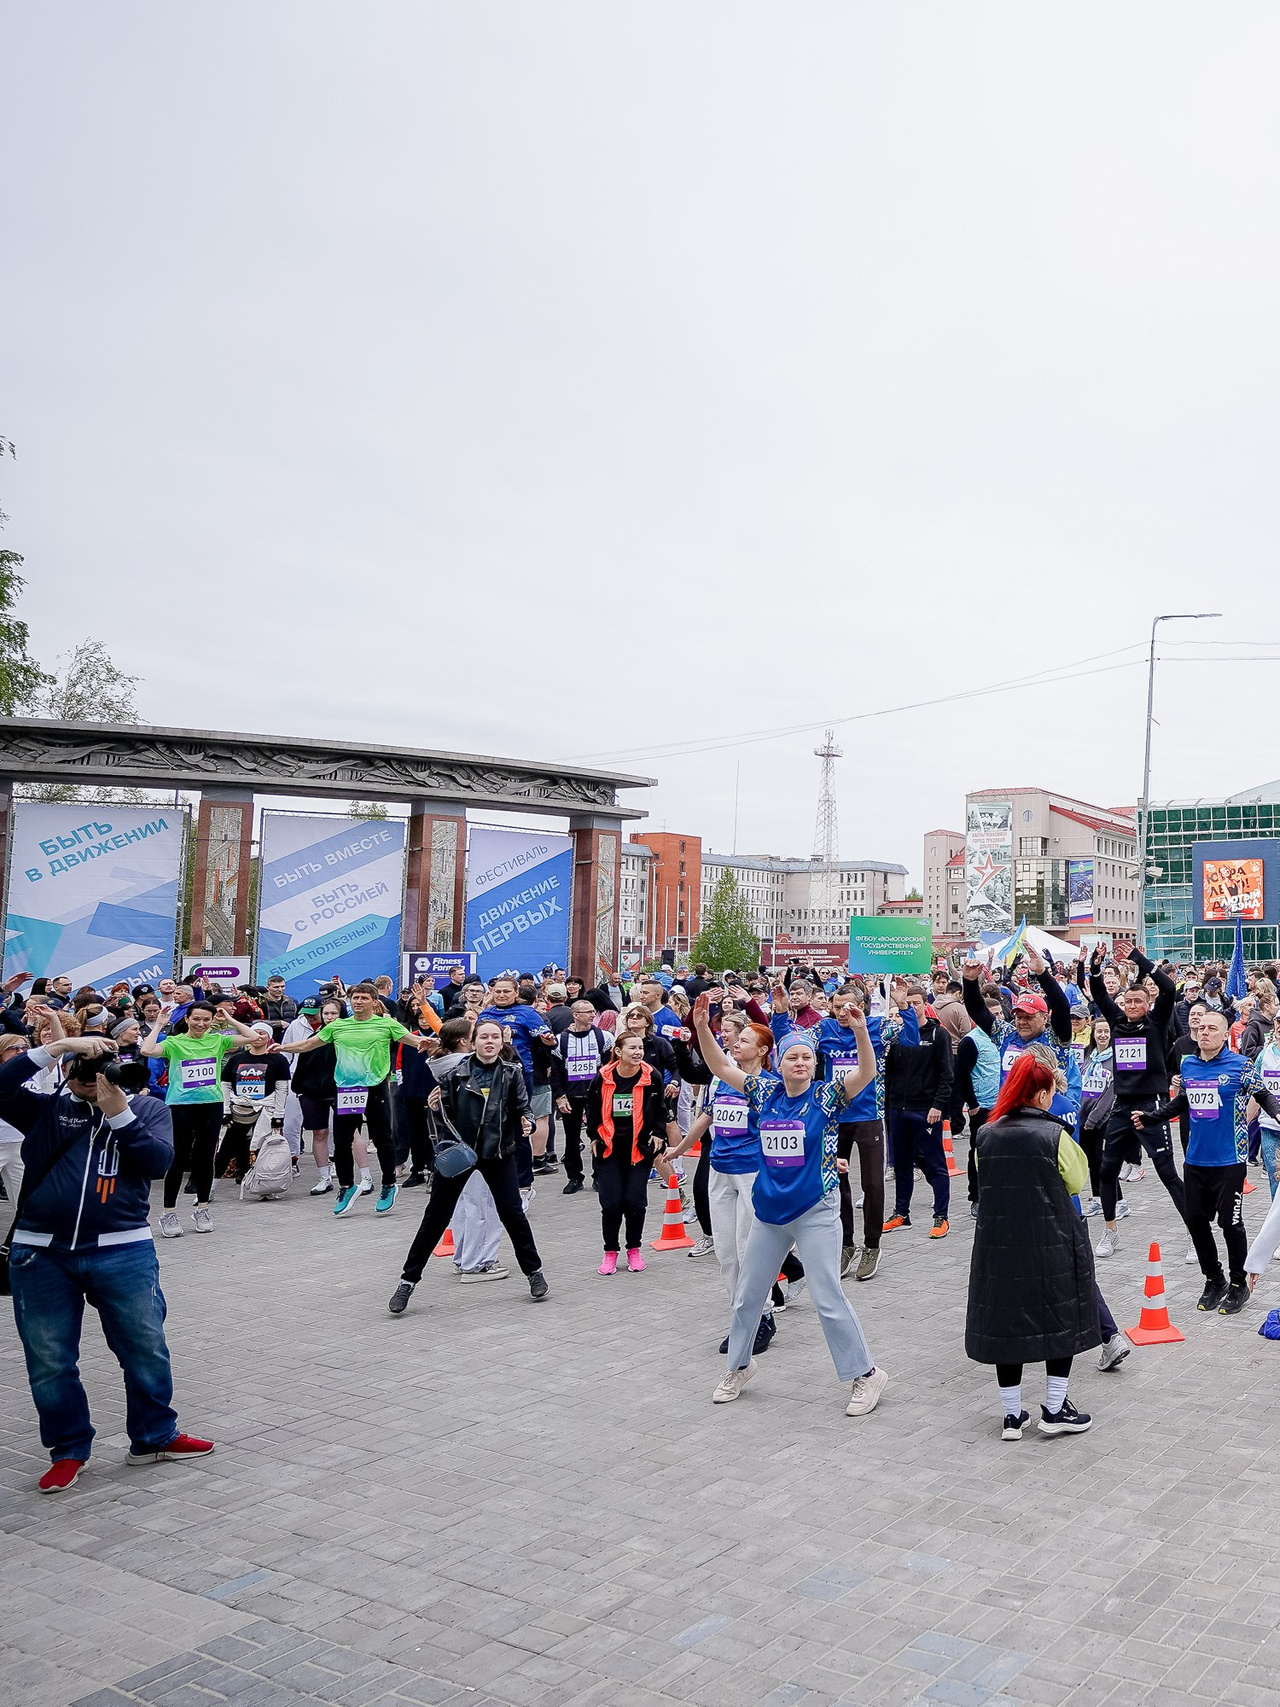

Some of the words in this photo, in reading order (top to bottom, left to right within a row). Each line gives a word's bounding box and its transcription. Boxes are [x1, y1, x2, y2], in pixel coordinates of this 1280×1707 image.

[39, 821, 113, 856] БЫТЬ
[25, 868, 43, 883] В
[48, 818, 170, 877] ДВИЖЕНИИ
[272, 861, 323, 889] БЫТЬ
[323, 829, 394, 868] ВМЕСТЕ
[475, 844, 549, 886] ФЕСТИВАЛЬ
[311, 881, 360, 909] БЫТЬ
[478, 875, 561, 930] ДВИЖЕНИЕ
[293, 919, 308, 933] С
[309, 880, 390, 927] РОССИЕЙ
[471, 895, 563, 957] ПЕРВЫХ
[269, 956, 306, 978] БЫТЬ
[306, 921, 378, 960] ПОЛЕЗНЫМ
[433, 957, 462, 966] Fitness
[1119, 1048, 1141, 1058] 2121
[188, 1066, 214, 1078] 2100
[572, 1062, 594, 1072] 2255
[241, 1084, 259, 1094] 694
[1189, 1093, 1214, 1104] 2073
[342, 1095, 366, 1105] 2185
[717, 1110, 743, 1122] 2067
[766, 1137, 798, 1150] 2103
